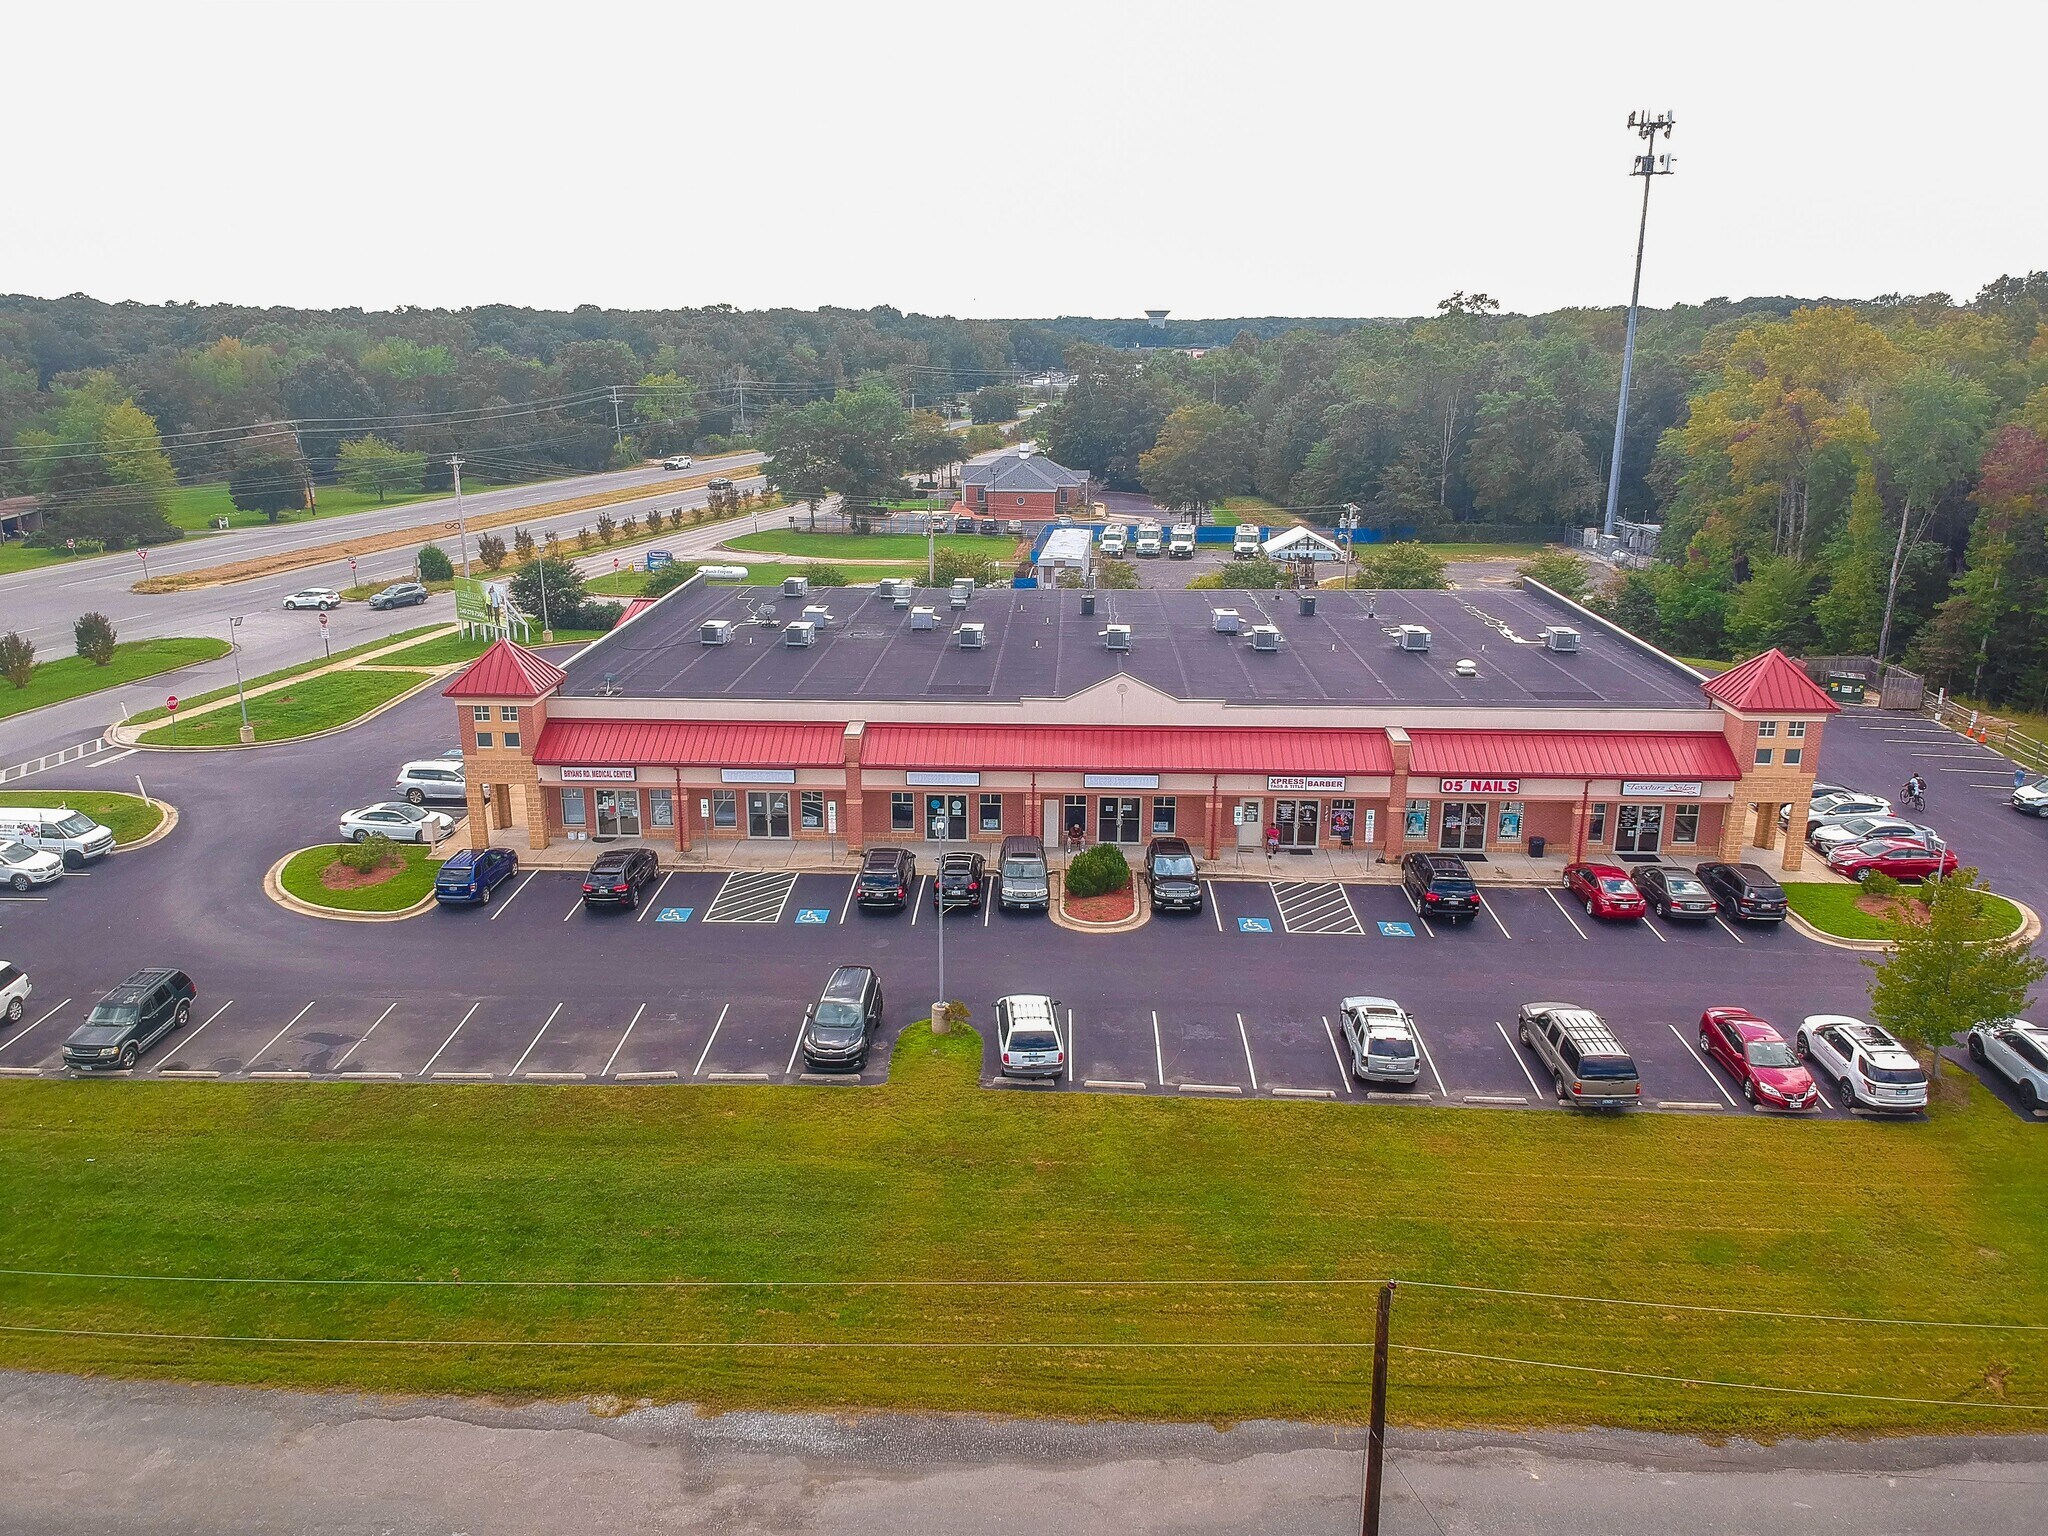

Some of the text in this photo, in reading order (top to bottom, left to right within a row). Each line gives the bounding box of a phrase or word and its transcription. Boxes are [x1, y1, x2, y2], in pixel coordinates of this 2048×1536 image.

[563, 770, 582, 778] BRYANS
[591, 770, 613, 778] MEDICAL
[613, 770, 633, 778] CENTER
[1307, 780, 1343, 788] BARBER
[1470, 781, 1518, 792] NAILS
[1668, 783, 1697, 791] Salon
